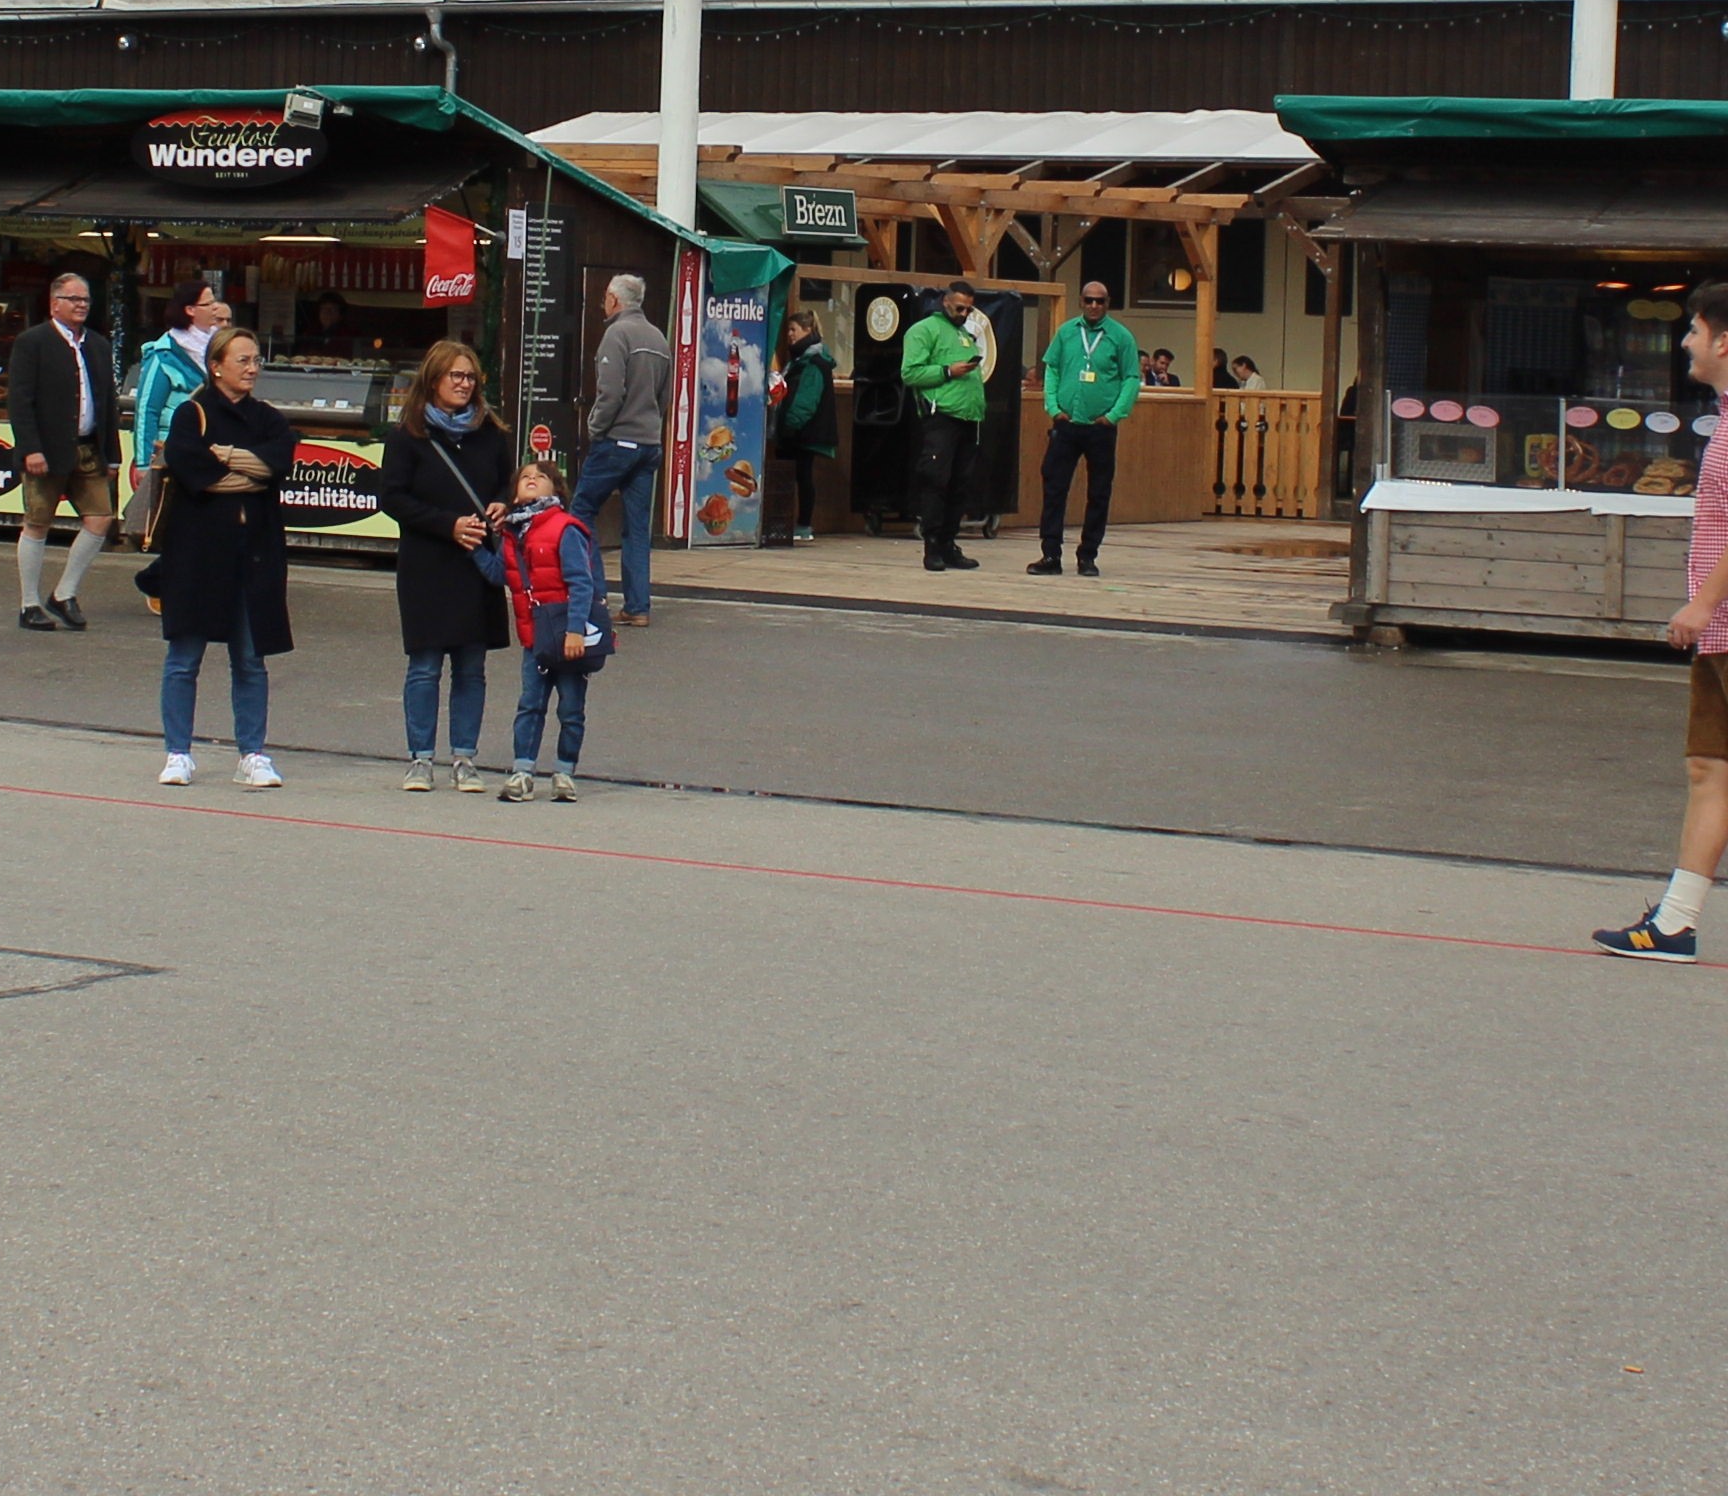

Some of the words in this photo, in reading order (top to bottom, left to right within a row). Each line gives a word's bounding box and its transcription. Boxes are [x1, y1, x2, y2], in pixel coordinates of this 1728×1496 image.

[180, 112, 280, 151] Feinkost
[148, 144, 312, 168] Wunderer
[426, 272, 476, 300] Coca-Cola
[706, 296, 765, 322] Getränke
[279, 485, 377, 510] ezialitäten
[1628, 928, 1656, 951] N
